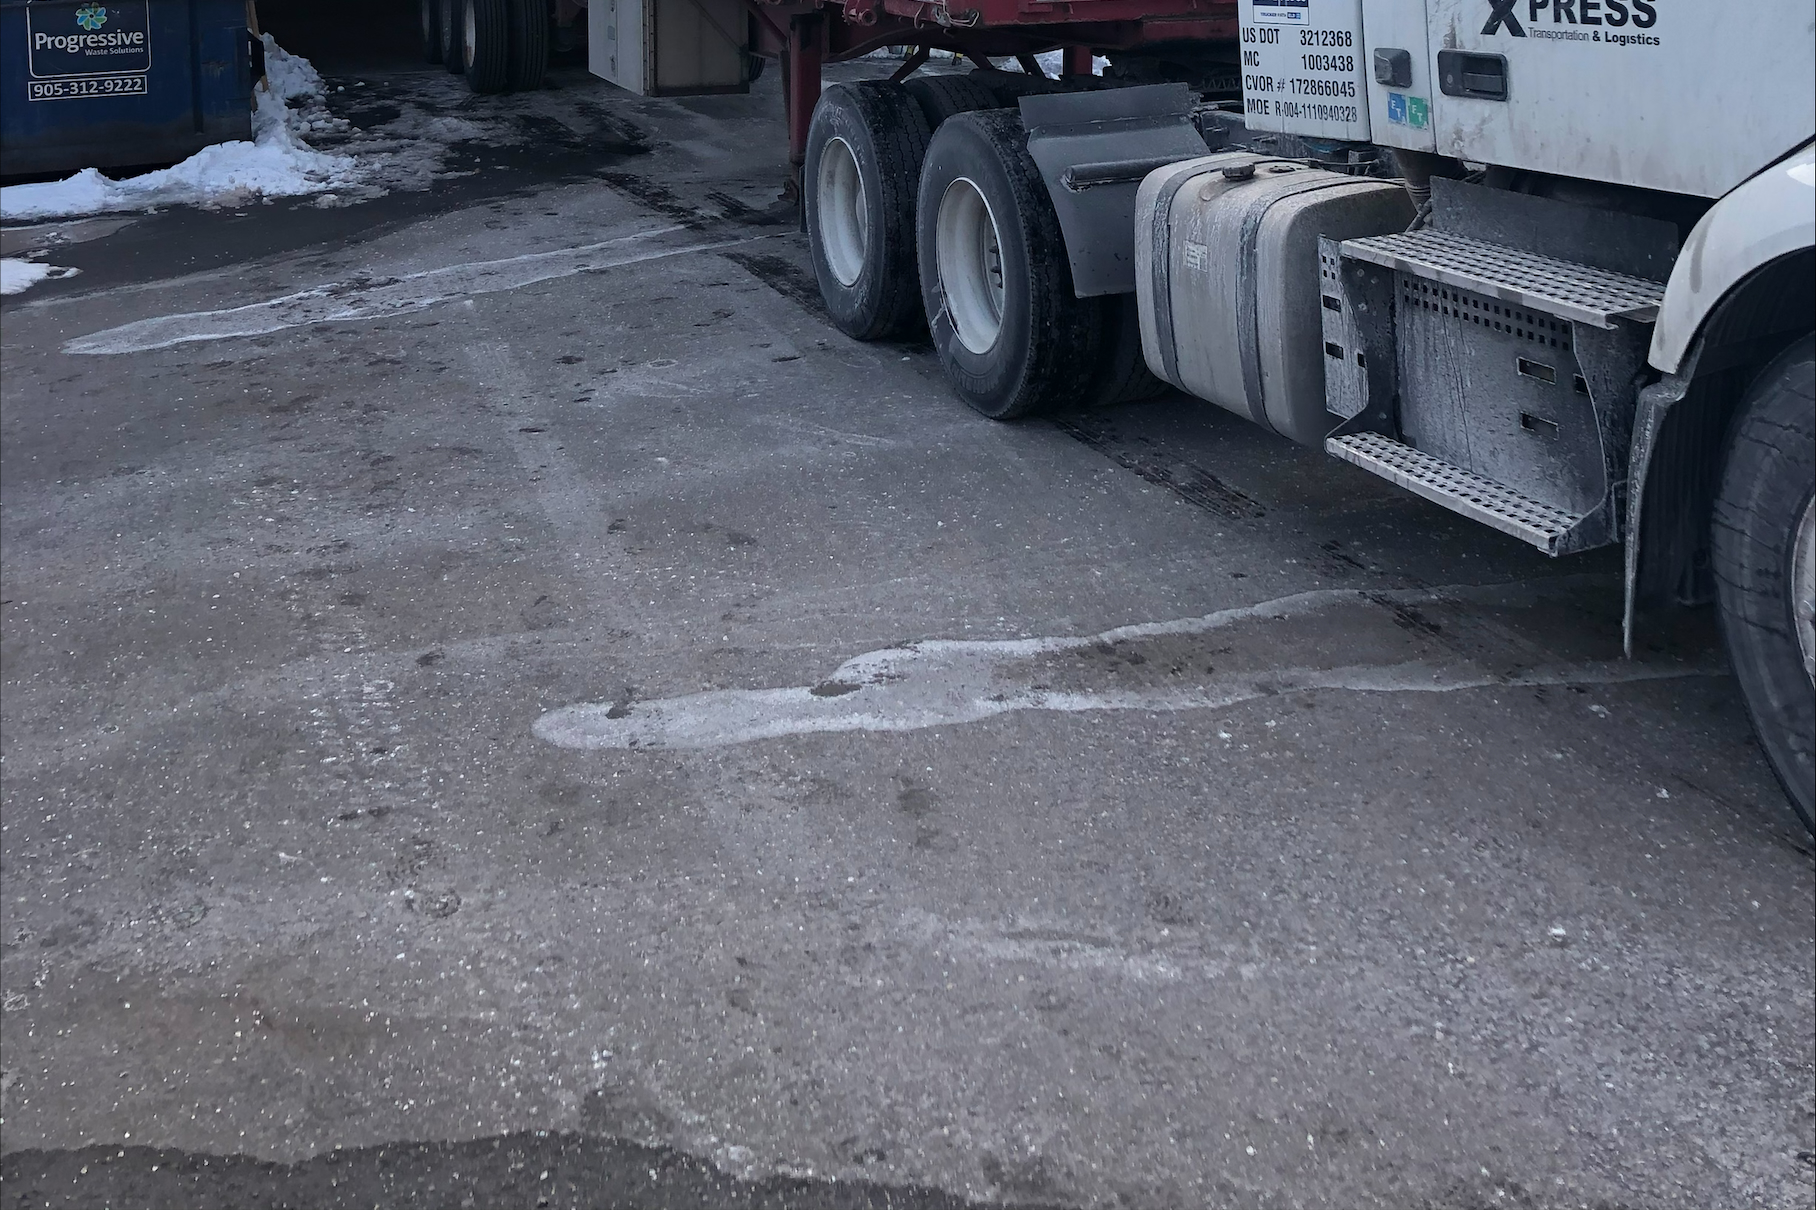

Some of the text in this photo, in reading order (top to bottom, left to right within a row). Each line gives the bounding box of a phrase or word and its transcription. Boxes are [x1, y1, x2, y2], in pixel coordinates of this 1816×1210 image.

[34, 28, 144, 54] Progressive
[1242, 27, 1353, 48] US DOT 3212368
[1528, 27, 1661, 47] Transportation & Logistics
[85, 45, 144, 57] Waste Solutions
[1243, 50, 1354, 72] MC 1003438
[33, 77, 143, 98] 905-312-9222
[1245, 74, 1356, 98] CVOR # 172866045
[1246, 97, 1358, 123] MOE R-004-1110940328
